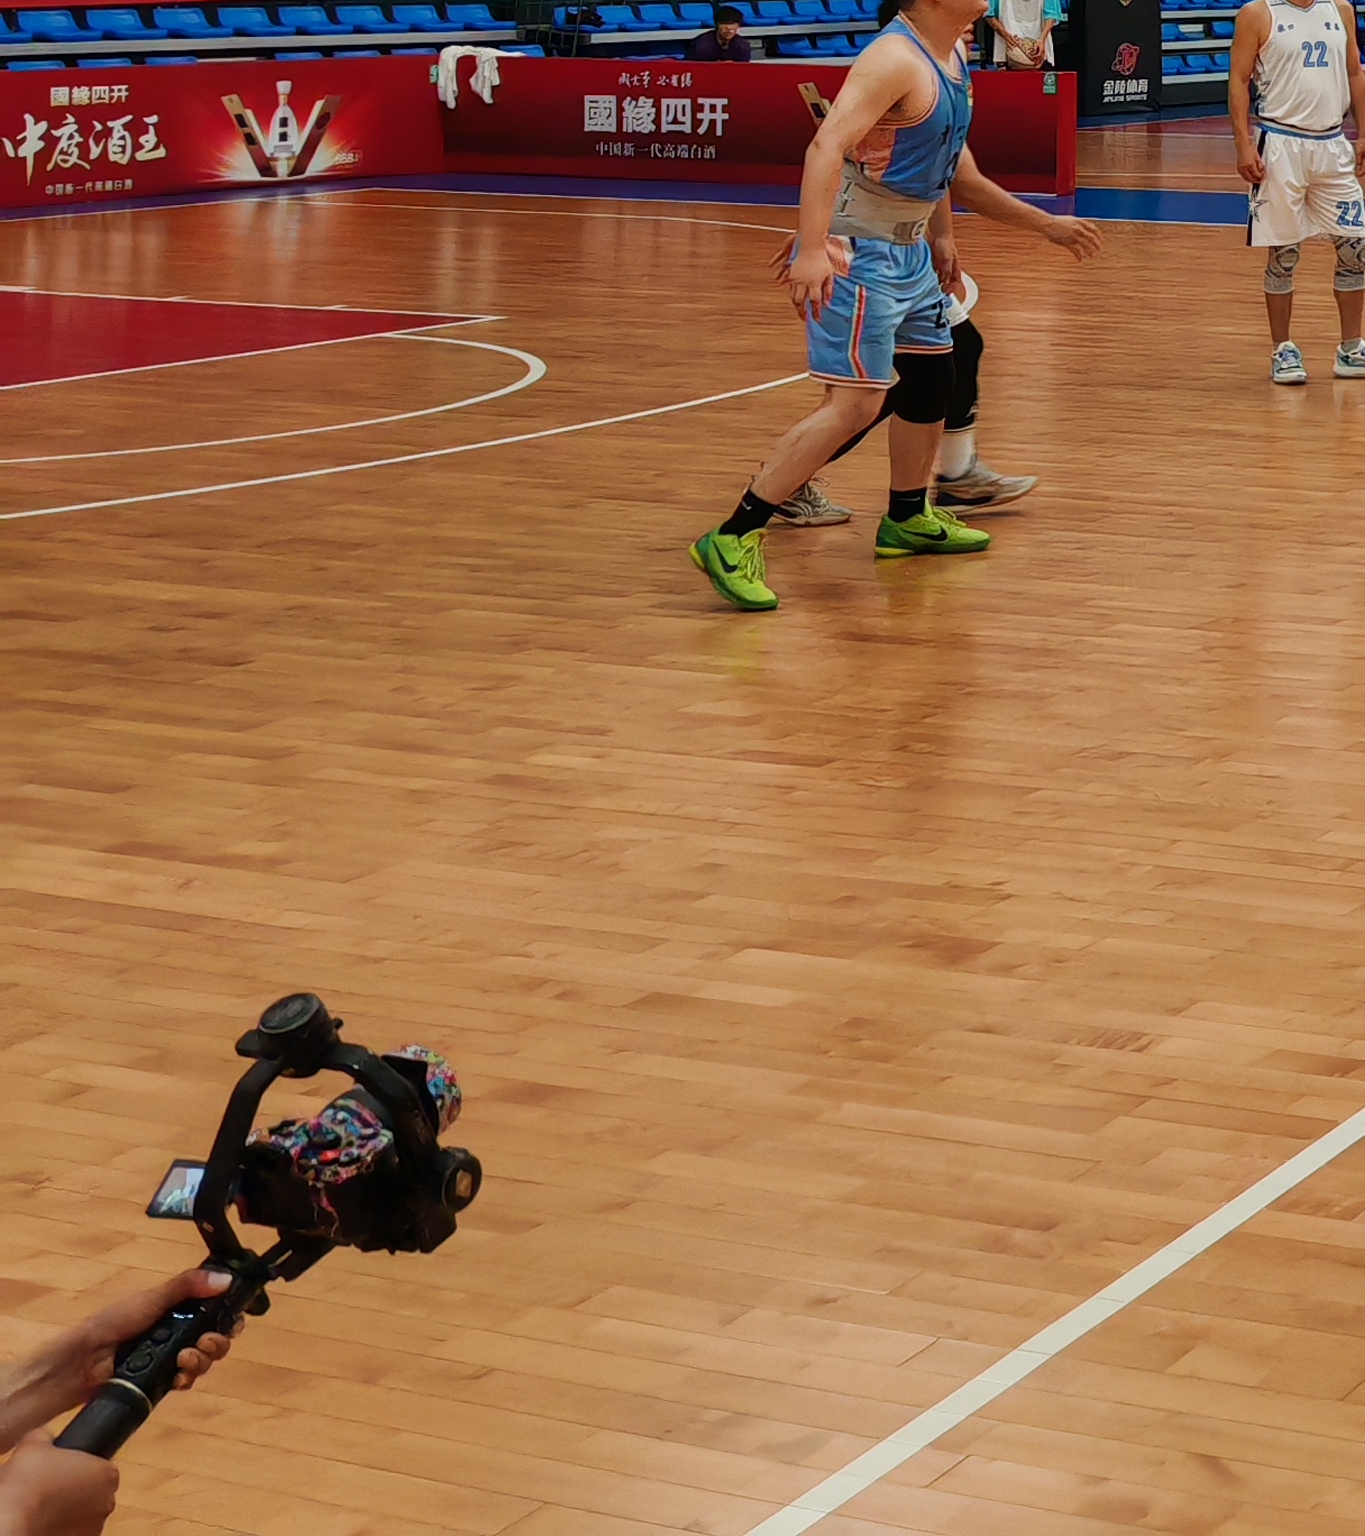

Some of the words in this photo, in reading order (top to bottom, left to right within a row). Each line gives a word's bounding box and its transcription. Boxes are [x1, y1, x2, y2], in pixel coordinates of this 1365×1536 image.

[1301, 41, 1329, 67] 22
[1102, 79, 1149, 96] 金陵体育
[2, 113, 166, 186] 中度酒王
[596, 141, 716, 159] 中国新一代高端白酒
[1335, 200, 1363, 227] 22
